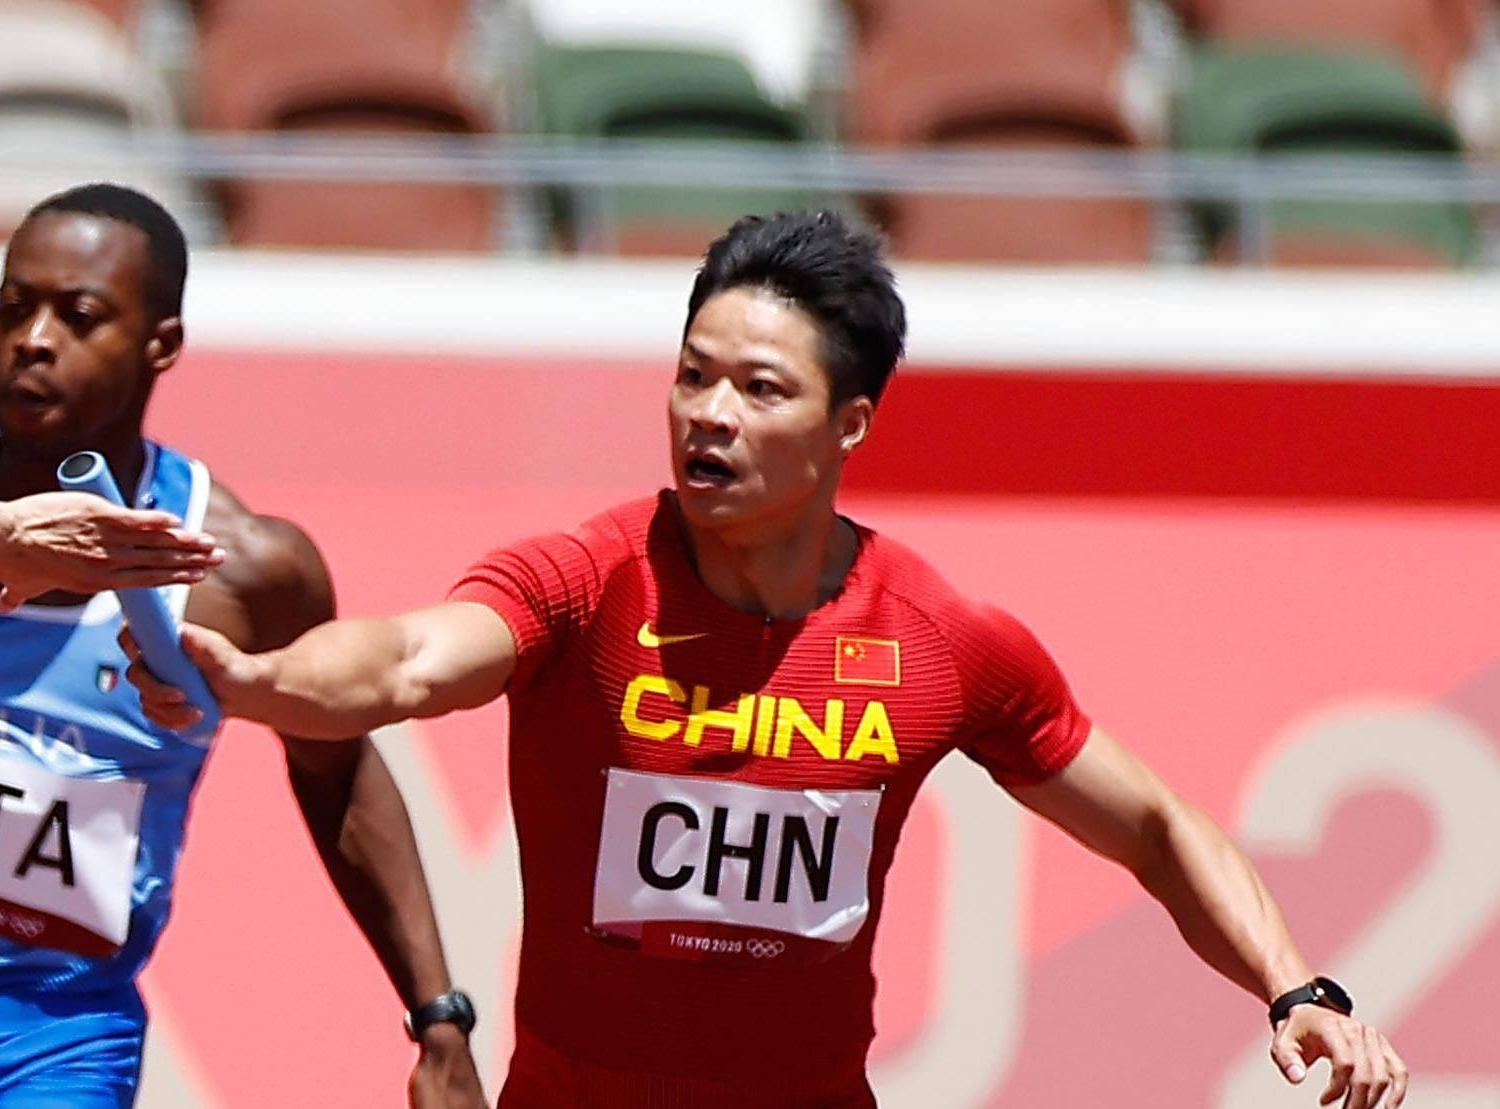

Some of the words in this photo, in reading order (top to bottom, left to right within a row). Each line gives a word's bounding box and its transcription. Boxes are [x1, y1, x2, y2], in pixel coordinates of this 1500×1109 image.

[620, 673, 900, 764] CHINA
[636, 801, 841, 904] CHN
[669, 933, 711, 950] TOKYO
[712, 938, 743, 953] 2020
